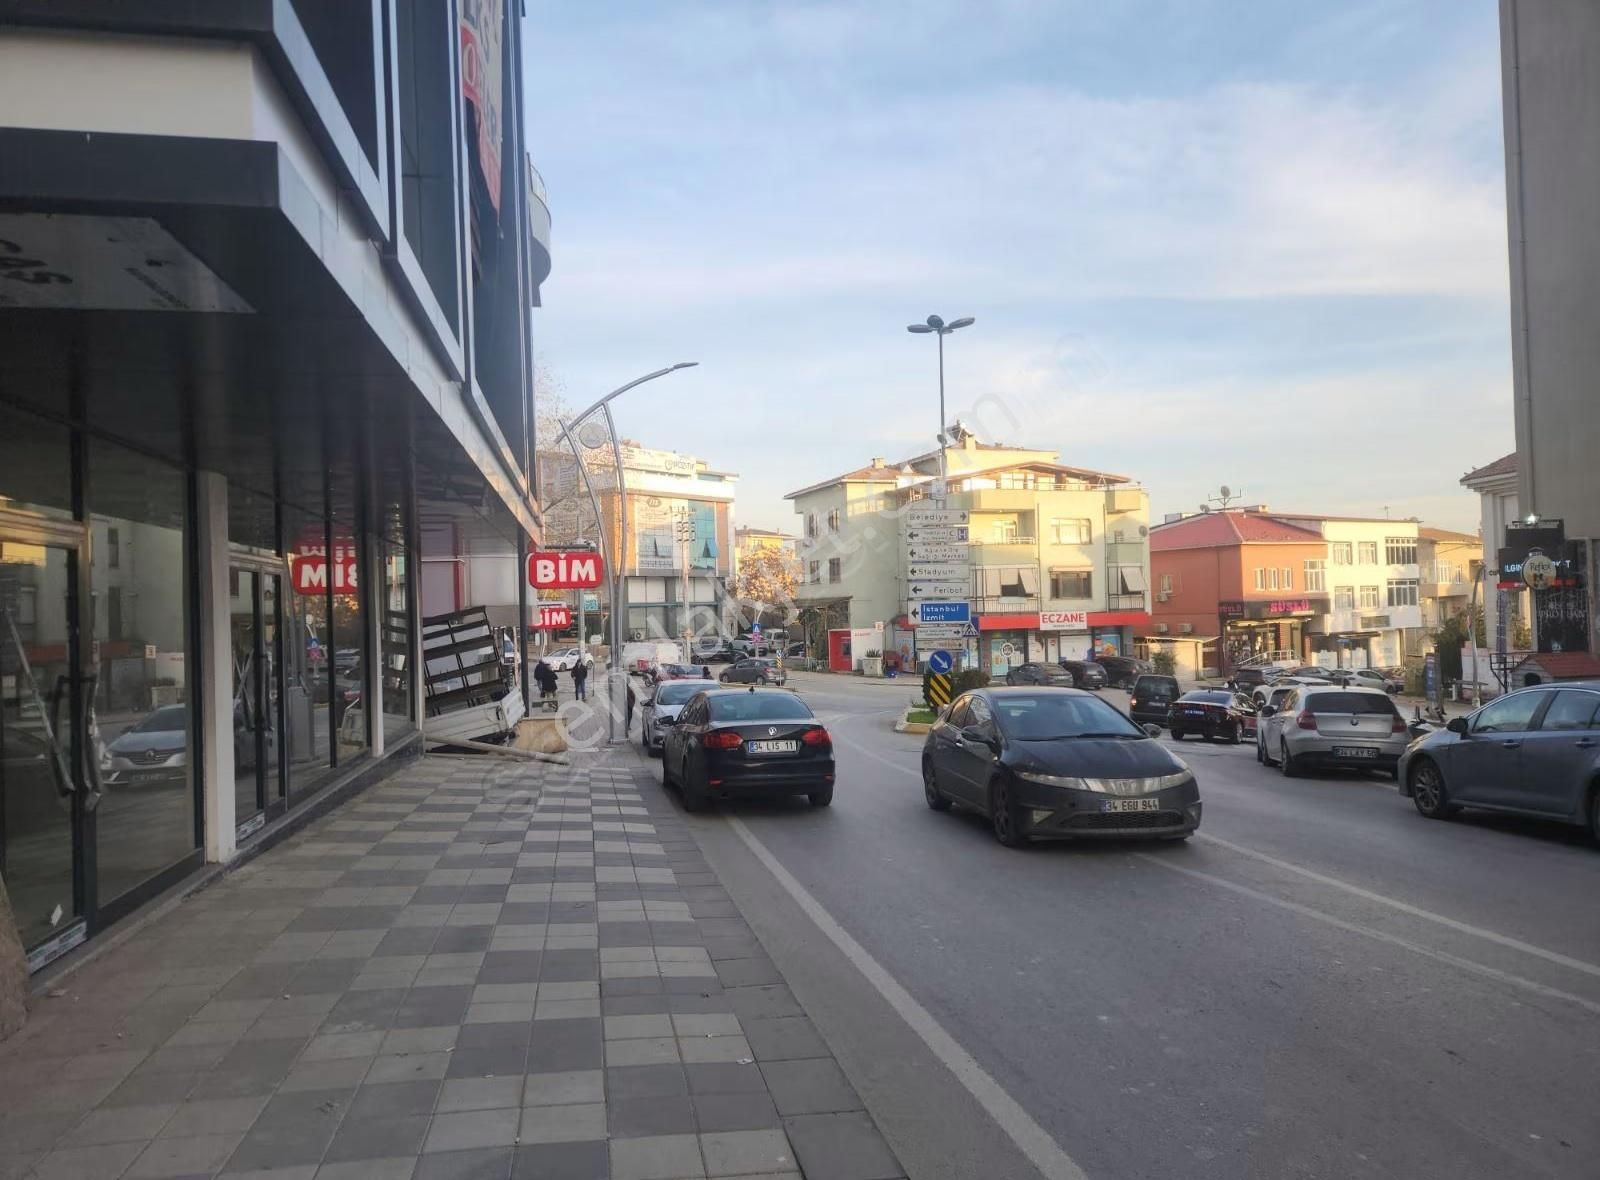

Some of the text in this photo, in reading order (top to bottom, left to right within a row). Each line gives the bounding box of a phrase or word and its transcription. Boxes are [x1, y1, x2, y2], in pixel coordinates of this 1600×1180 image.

[910, 513, 948, 522] Belediye
[536, 553, 596, 583] BİM
[918, 568, 954, 576] Stadyum
[923, 603, 959, 612] İstanbul
[1270, 598, 1309, 613] SÜSLÜ
[923, 613, 945, 621] İzmit
[1041, 613, 1085, 623] ECZANE
[754, 742, 793, 751] 34 LIS 11
[1106, 800, 1158, 811] 34 EGU 944
